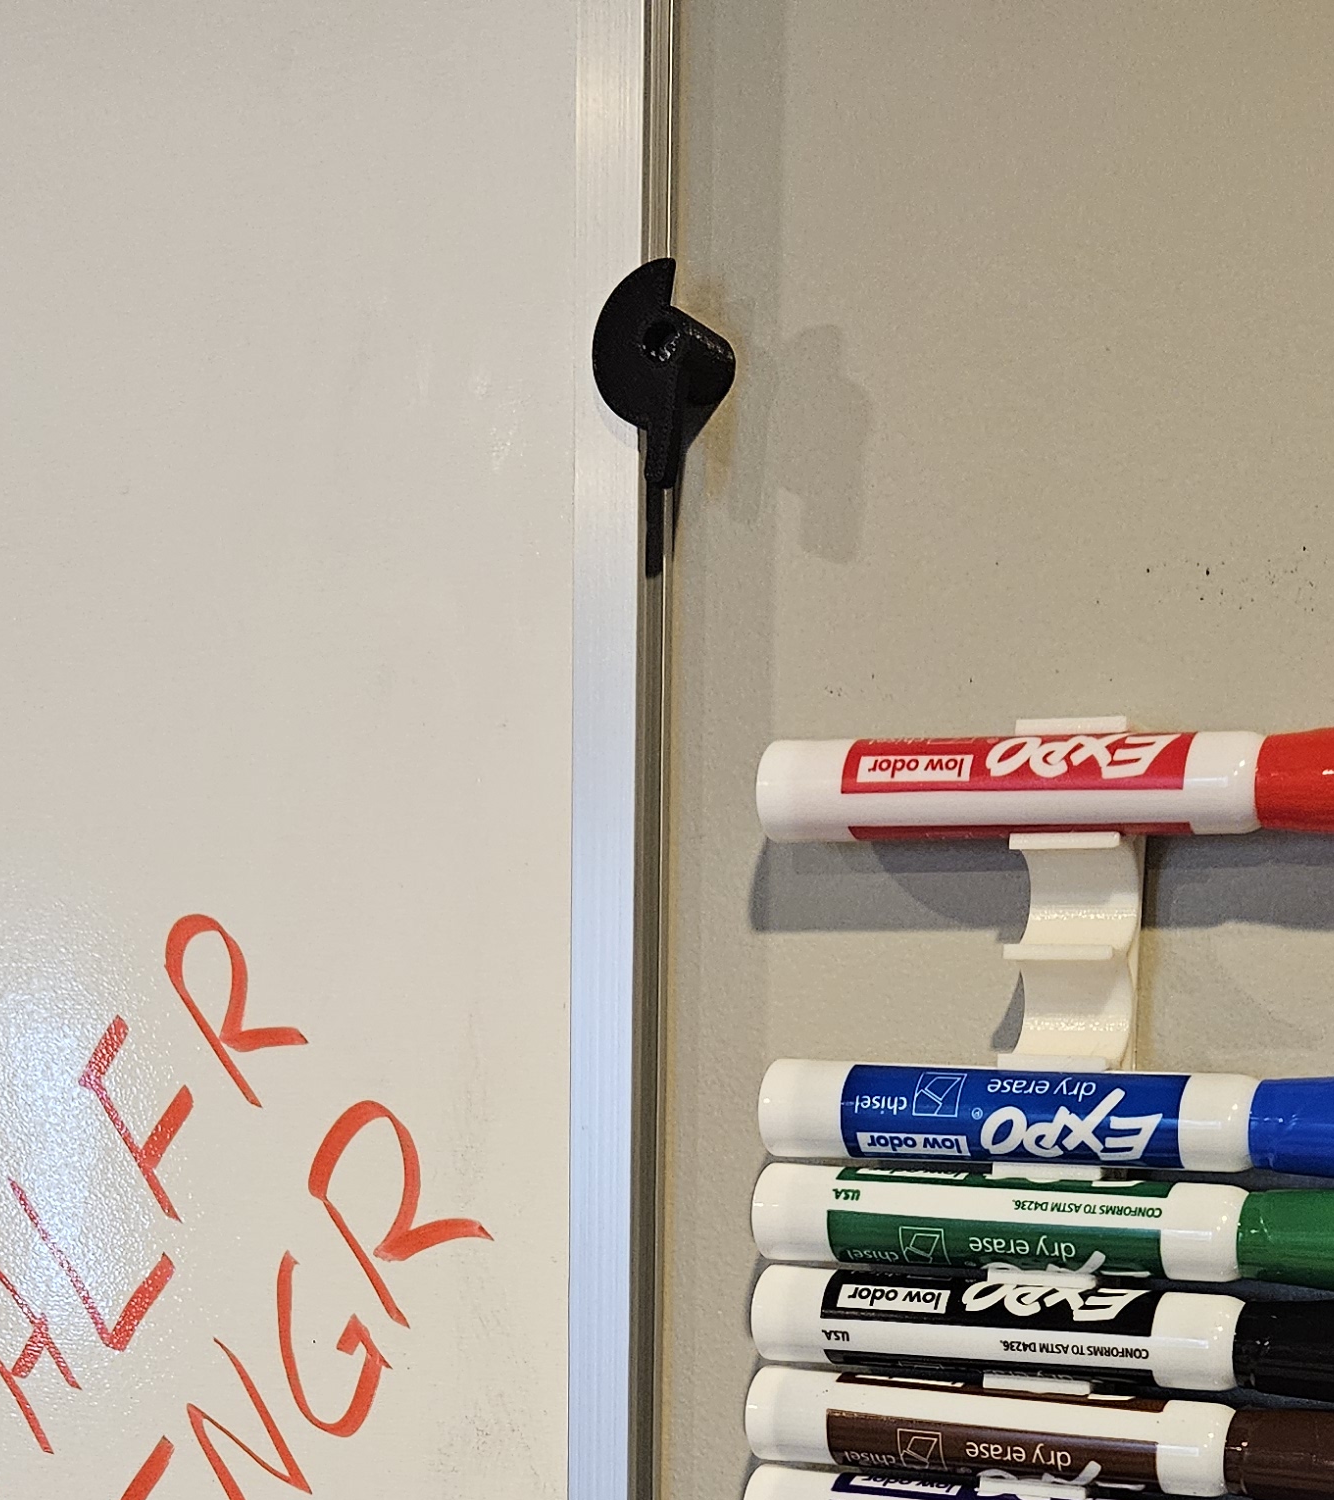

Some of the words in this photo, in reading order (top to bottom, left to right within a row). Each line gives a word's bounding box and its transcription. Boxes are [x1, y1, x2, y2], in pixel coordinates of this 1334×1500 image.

[985, 734, 1181, 779] EXPO
[868, 759, 920, 779] odor
[925, 758, 965, 777] low
[987, 1078, 1050, 1096] erase
[1051, 1077, 1097, 1102] dry
[854, 1094, 908, 1114] chisel
[980, 1087, 1163, 1160] EXPO
[867, 1135, 917, 1152] odor
[924, 1137, 961, 1154] low
[1012, 1199, 1049, 1212] D4236.
[1050, 1202, 1082, 1213] ASTM
[1083, 1203, 1097, 1214] TO
[1099, 1204, 1163, 1218] CONFORMS
[845, 1248, 899, 1264] chisel
[968, 1236, 1028, 1258] erase
[1035, 1235, 1076, 1261] dry
[847, 1287, 898, 1306] odor
[903, 1290, 942, 1310] low
[999, 1340, 1037, 1353] D4236.
[1038, 1342, 1070, 1355] ASTM
[1071, 1344, 1085, 1356] TO
[1087, 1345, 1149, 1360] CONFORMS
[844, 1451, 896, 1467] chisel
[965, 1441, 1025, 1465] erase
[1031, 1442, 1071, 1470] dry
